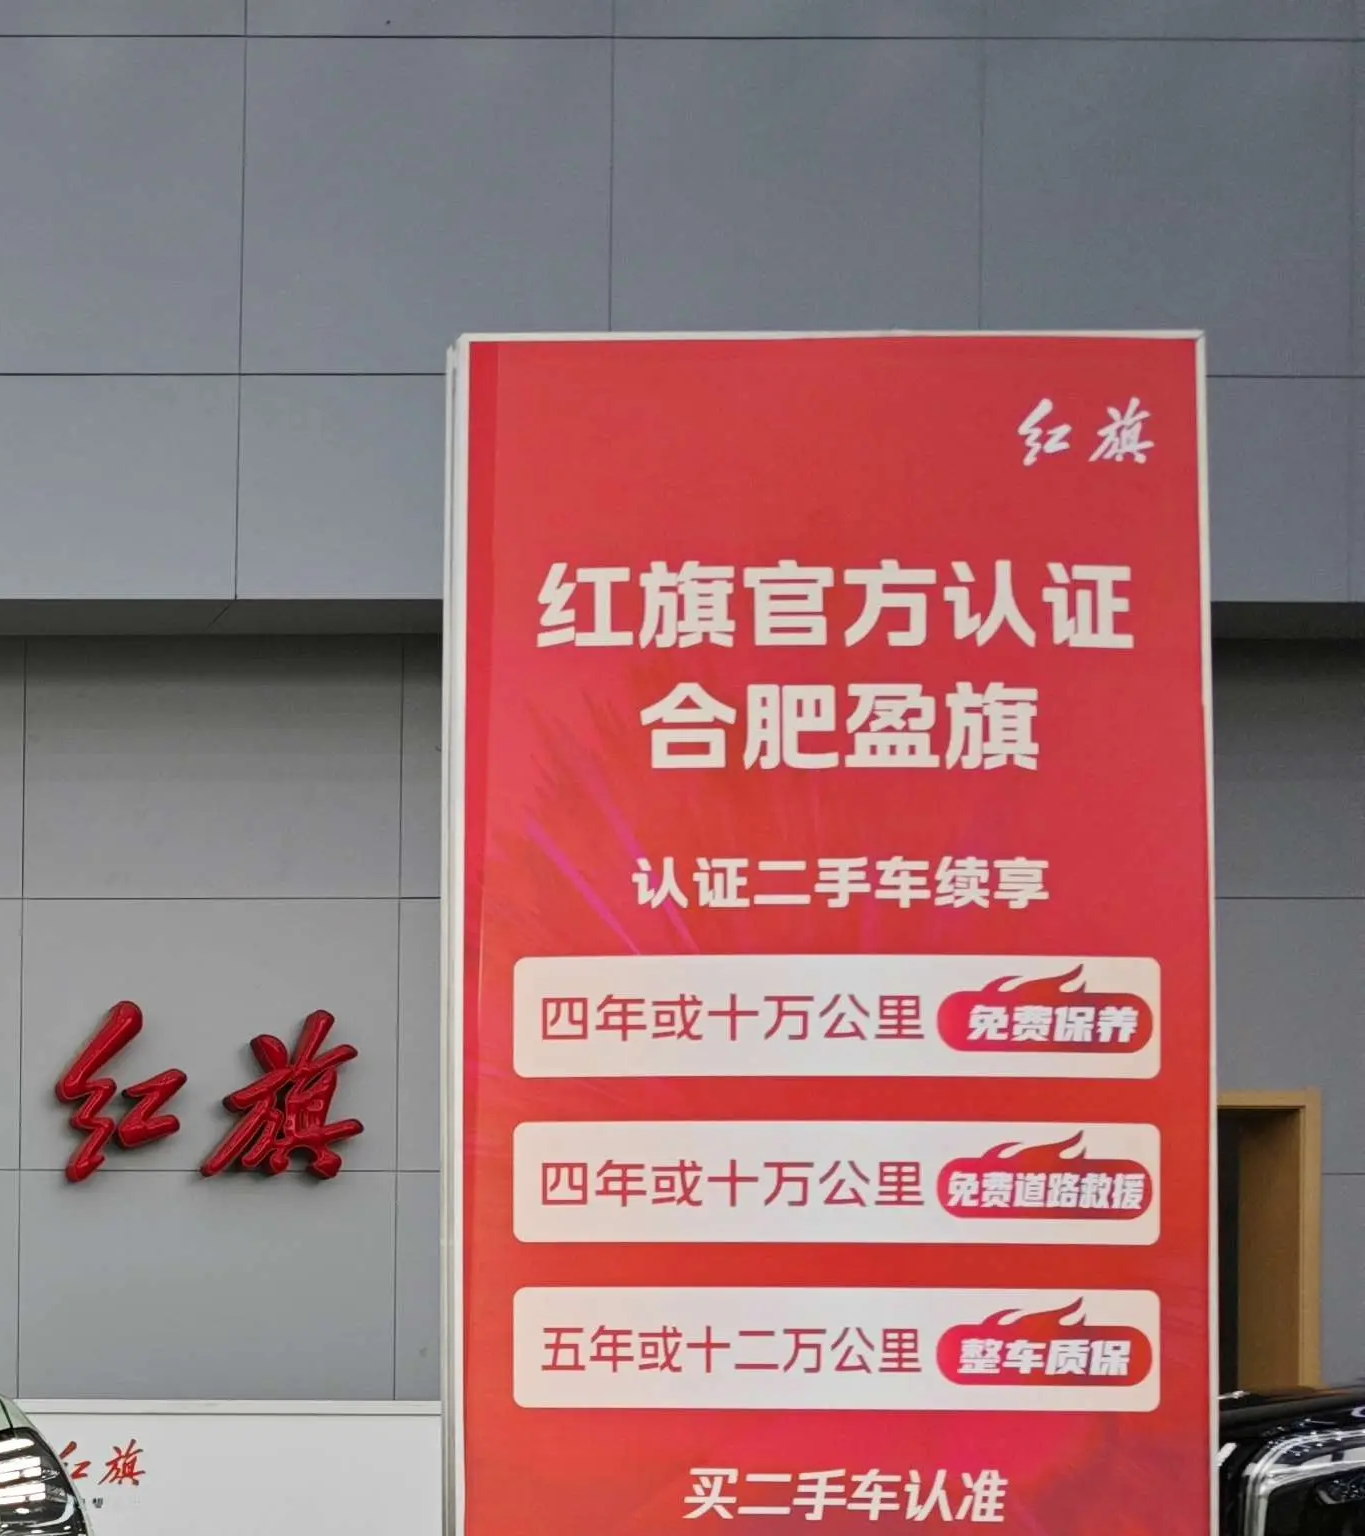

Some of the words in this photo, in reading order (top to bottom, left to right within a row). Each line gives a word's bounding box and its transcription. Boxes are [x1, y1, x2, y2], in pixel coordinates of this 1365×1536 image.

[1016, 397, 1154, 466] 红旗
[536, 559, 1135, 649] 红旗官方认证
[640, 682, 1040, 771] 合肥盈旗
[631, 857, 1050, 910] 认证二手车续享
[540, 993, 925, 1041] 四年或十万公里
[967, 1004, 1139, 1043] 免费保养
[55, 1000, 365, 1183] 红旗
[540, 1159, 925, 1208] 四年或十万公里
[946, 1171, 1146, 1210] 免费道路救援
[540, 1325, 923, 1375] 五年或十二万公里
[957, 1338, 1131, 1376] 整车质保
[682, 1468, 1009, 1522] 买二手车认准
